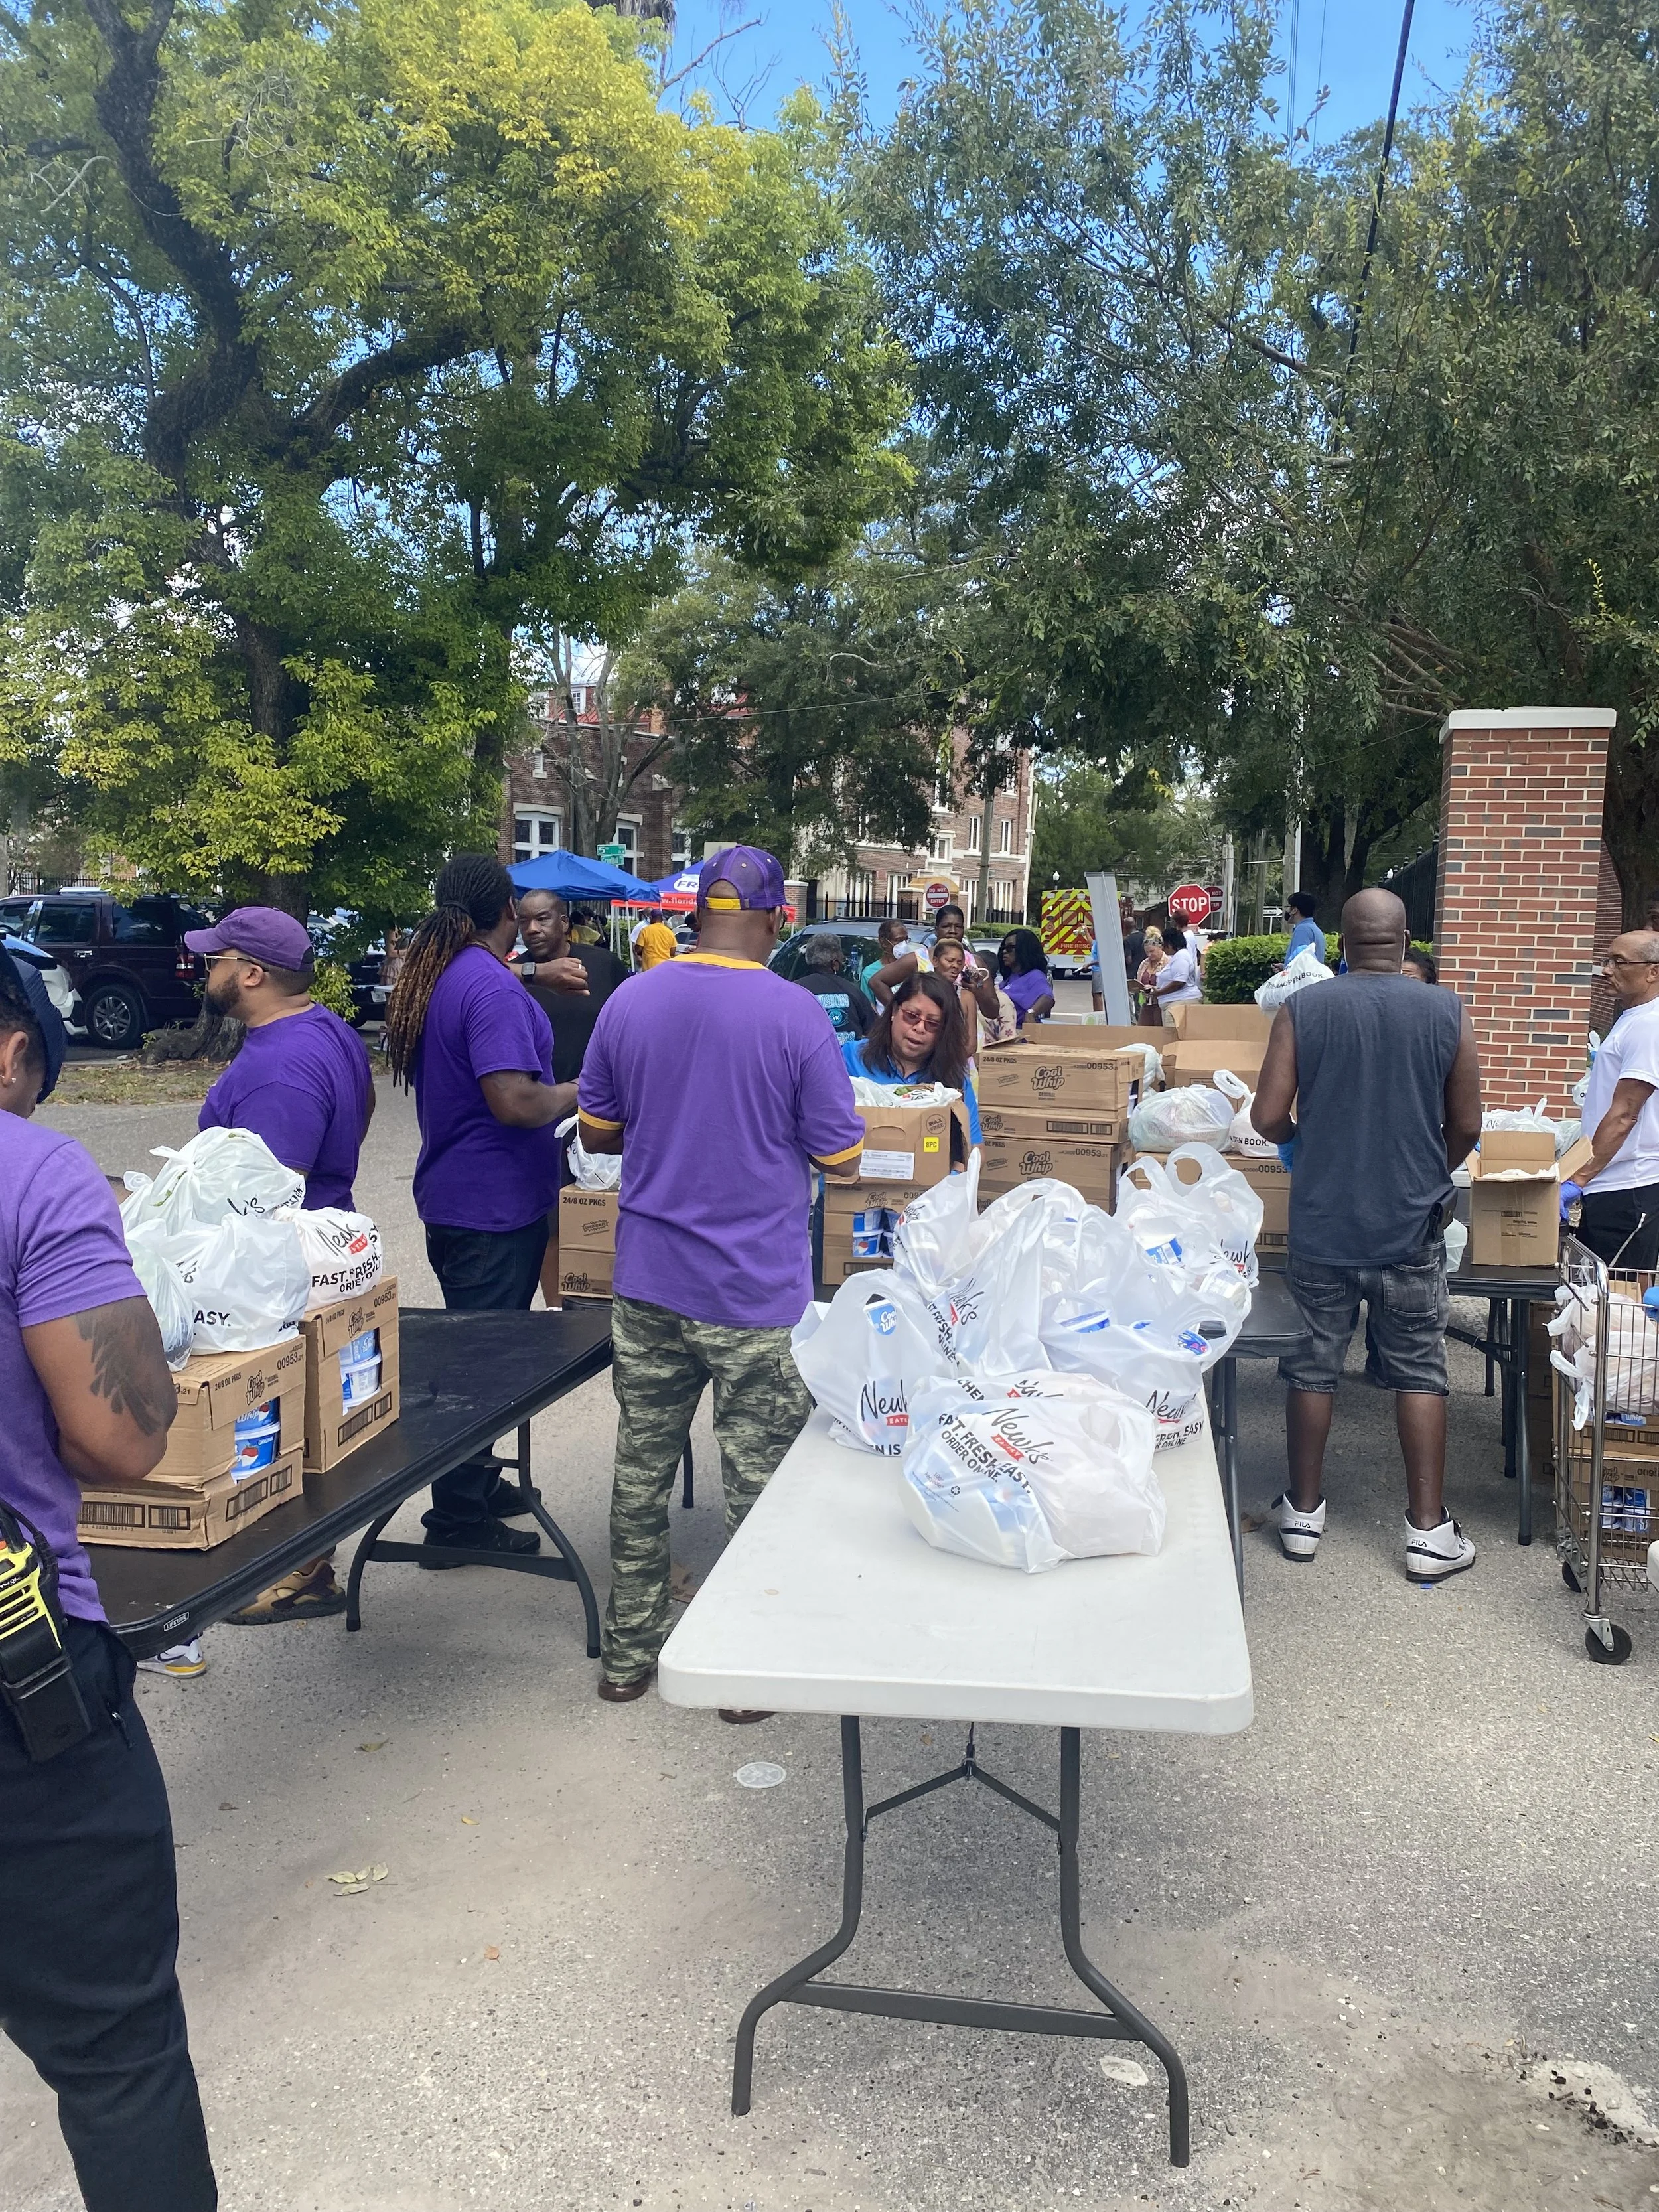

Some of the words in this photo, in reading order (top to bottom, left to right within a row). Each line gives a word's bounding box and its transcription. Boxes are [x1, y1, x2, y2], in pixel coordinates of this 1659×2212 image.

[1172, 897, 1208, 913] STOP
[1035, 1065, 1062, 1080] Cool
[1031, 1073, 1065, 1090] Whip
[981, 1121, 1003, 1132] Whip
[983, 1115, 1001, 1124] Cool
[1023, 1151, 1051, 1164] Cool
[1019, 1159, 1054, 1175] Whip
[865, 1198, 888, 1209] Whip
[867, 1192, 887, 1201] Cool
[311, 1270, 349, 1288] FAST.
[564, 1272, 588, 1284] Cool
[562, 1280, 591, 1292] Whip
[225, 1377, 231, 1386] OZ
[231, 1372, 242, 1383] PKGS
[247, 1370, 263, 1392] Cool
[245, 1381, 265, 1406] Whip
[236, 1407, 259, 1424] Whip
[982, 1408, 1054, 1465] Newk's
[889, 1444, 901, 1455] IS
[941, 1430, 969, 1461] ORDER
[1411, 1539, 1427, 1548] FILA
